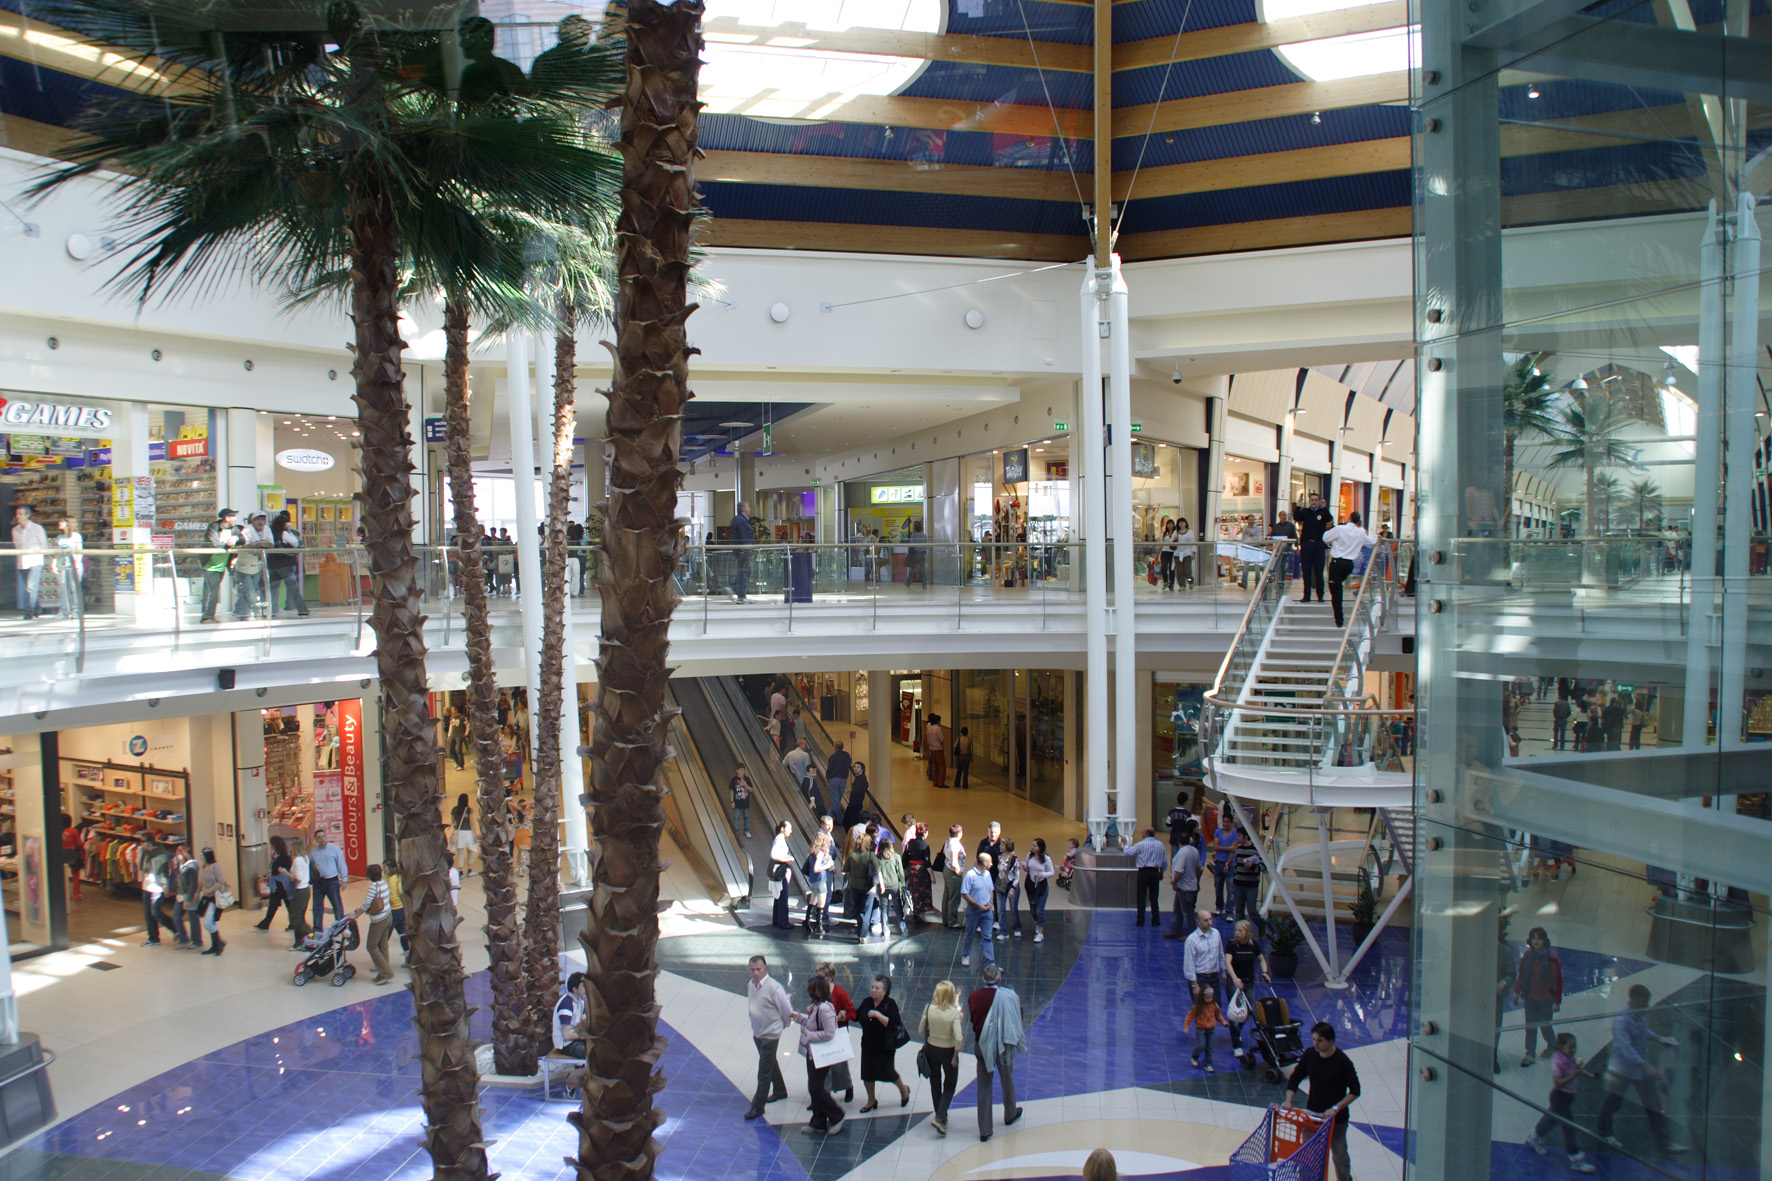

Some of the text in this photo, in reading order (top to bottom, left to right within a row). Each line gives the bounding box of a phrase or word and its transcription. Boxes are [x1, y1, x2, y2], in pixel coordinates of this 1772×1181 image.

[5, 402, 113, 429] GAMES
[286, 455, 322, 464] swatch
[175, 522, 208, 530] GAMES
[344, 714, 357, 775] Beauty
[347, 797, 359, 860] Colours
